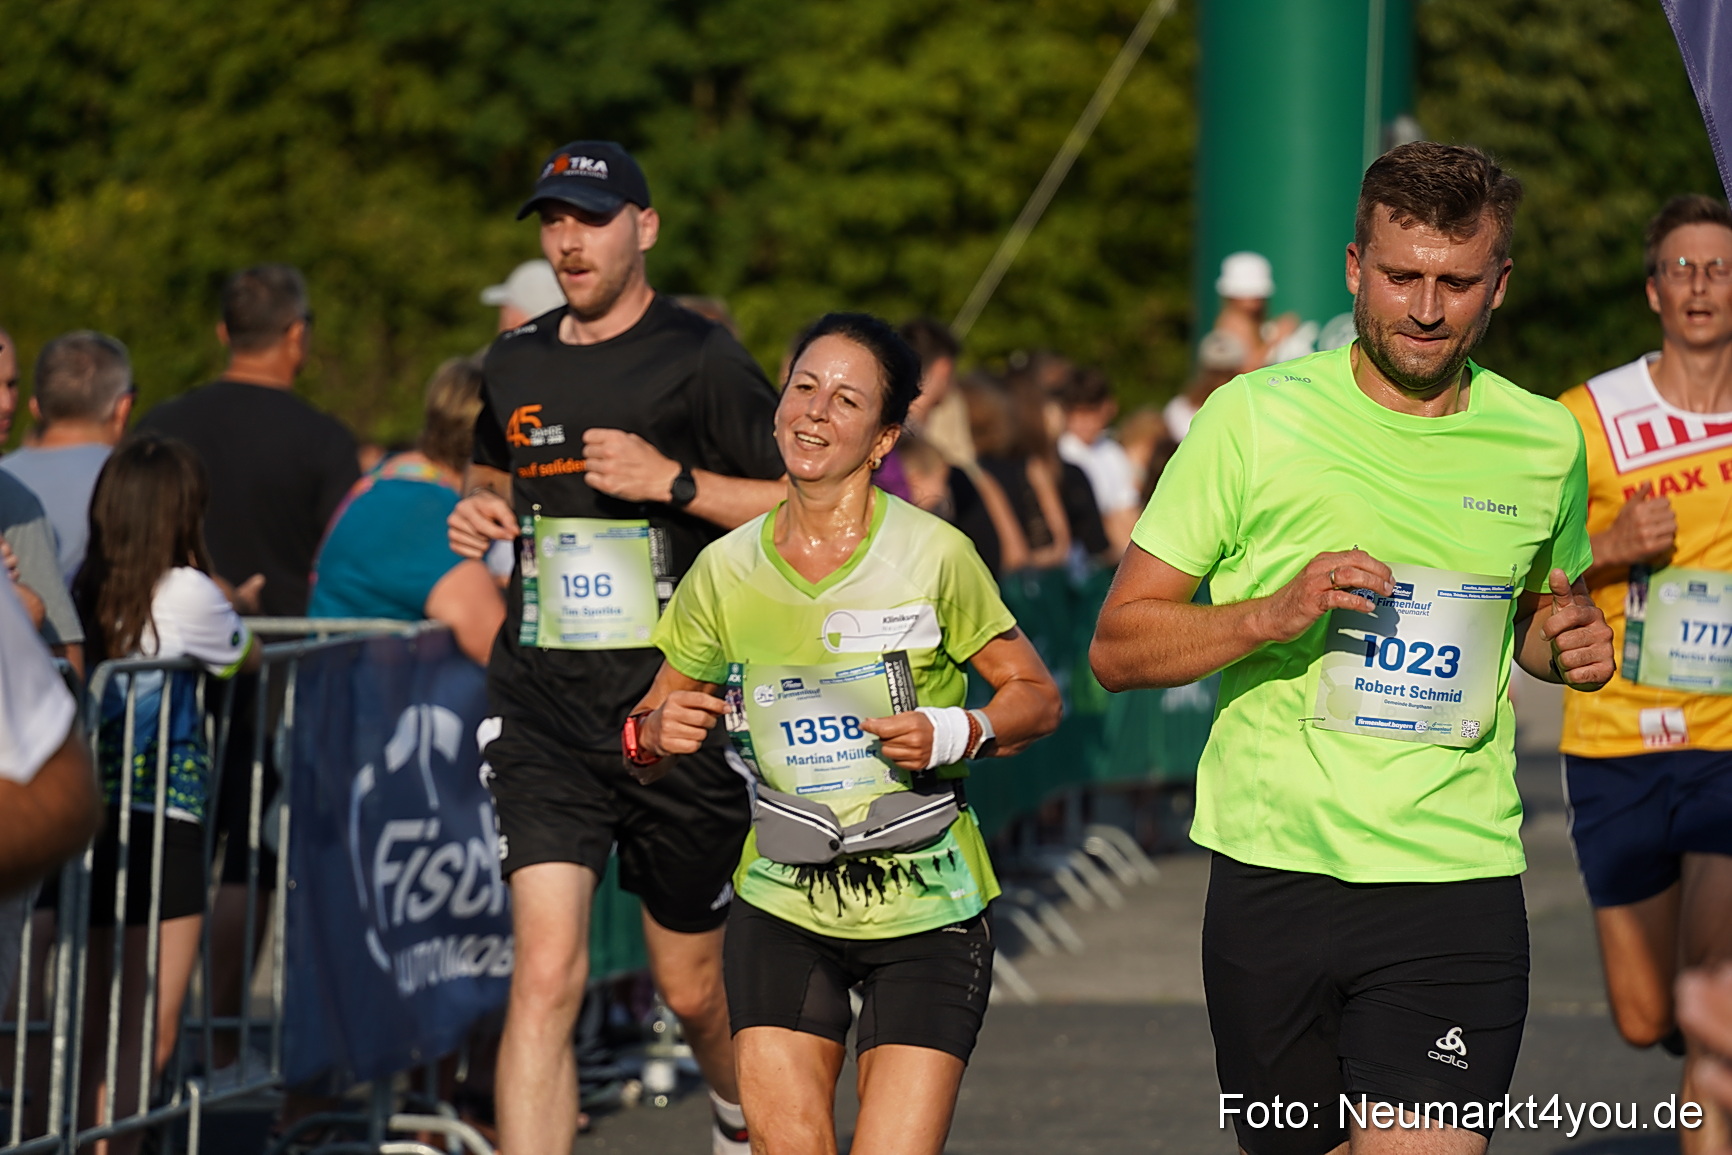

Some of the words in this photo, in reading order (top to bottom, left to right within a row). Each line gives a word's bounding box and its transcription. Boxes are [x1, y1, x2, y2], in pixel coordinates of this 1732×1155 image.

[1284, 375, 1312, 384] JAKO
[506, 404, 543, 448] 45
[530, 424, 564, 438] JAHRE
[517, 462, 538, 478] auf
[1623, 467, 1708, 506] MAX
[1462, 496, 1518, 518] Robert
[561, 573, 613, 599] 196
[1377, 597, 1433, 611] Firmenlauf
[1397, 608, 1430, 617] neumarkt
[1681, 619, 1732, 647] 1717
[1363, 633, 1461, 679] 1023
[1354, 677, 1406, 697] Robert
[1409, 685, 1463, 703] Schmid
[780, 715, 864, 746] 1358
[1357, 718, 1414, 730] firmenlauf.bayern
[786, 752, 834, 766] Martina
[836, 747, 878, 762] Müller
[1427, 1050, 1469, 1070] odlo
